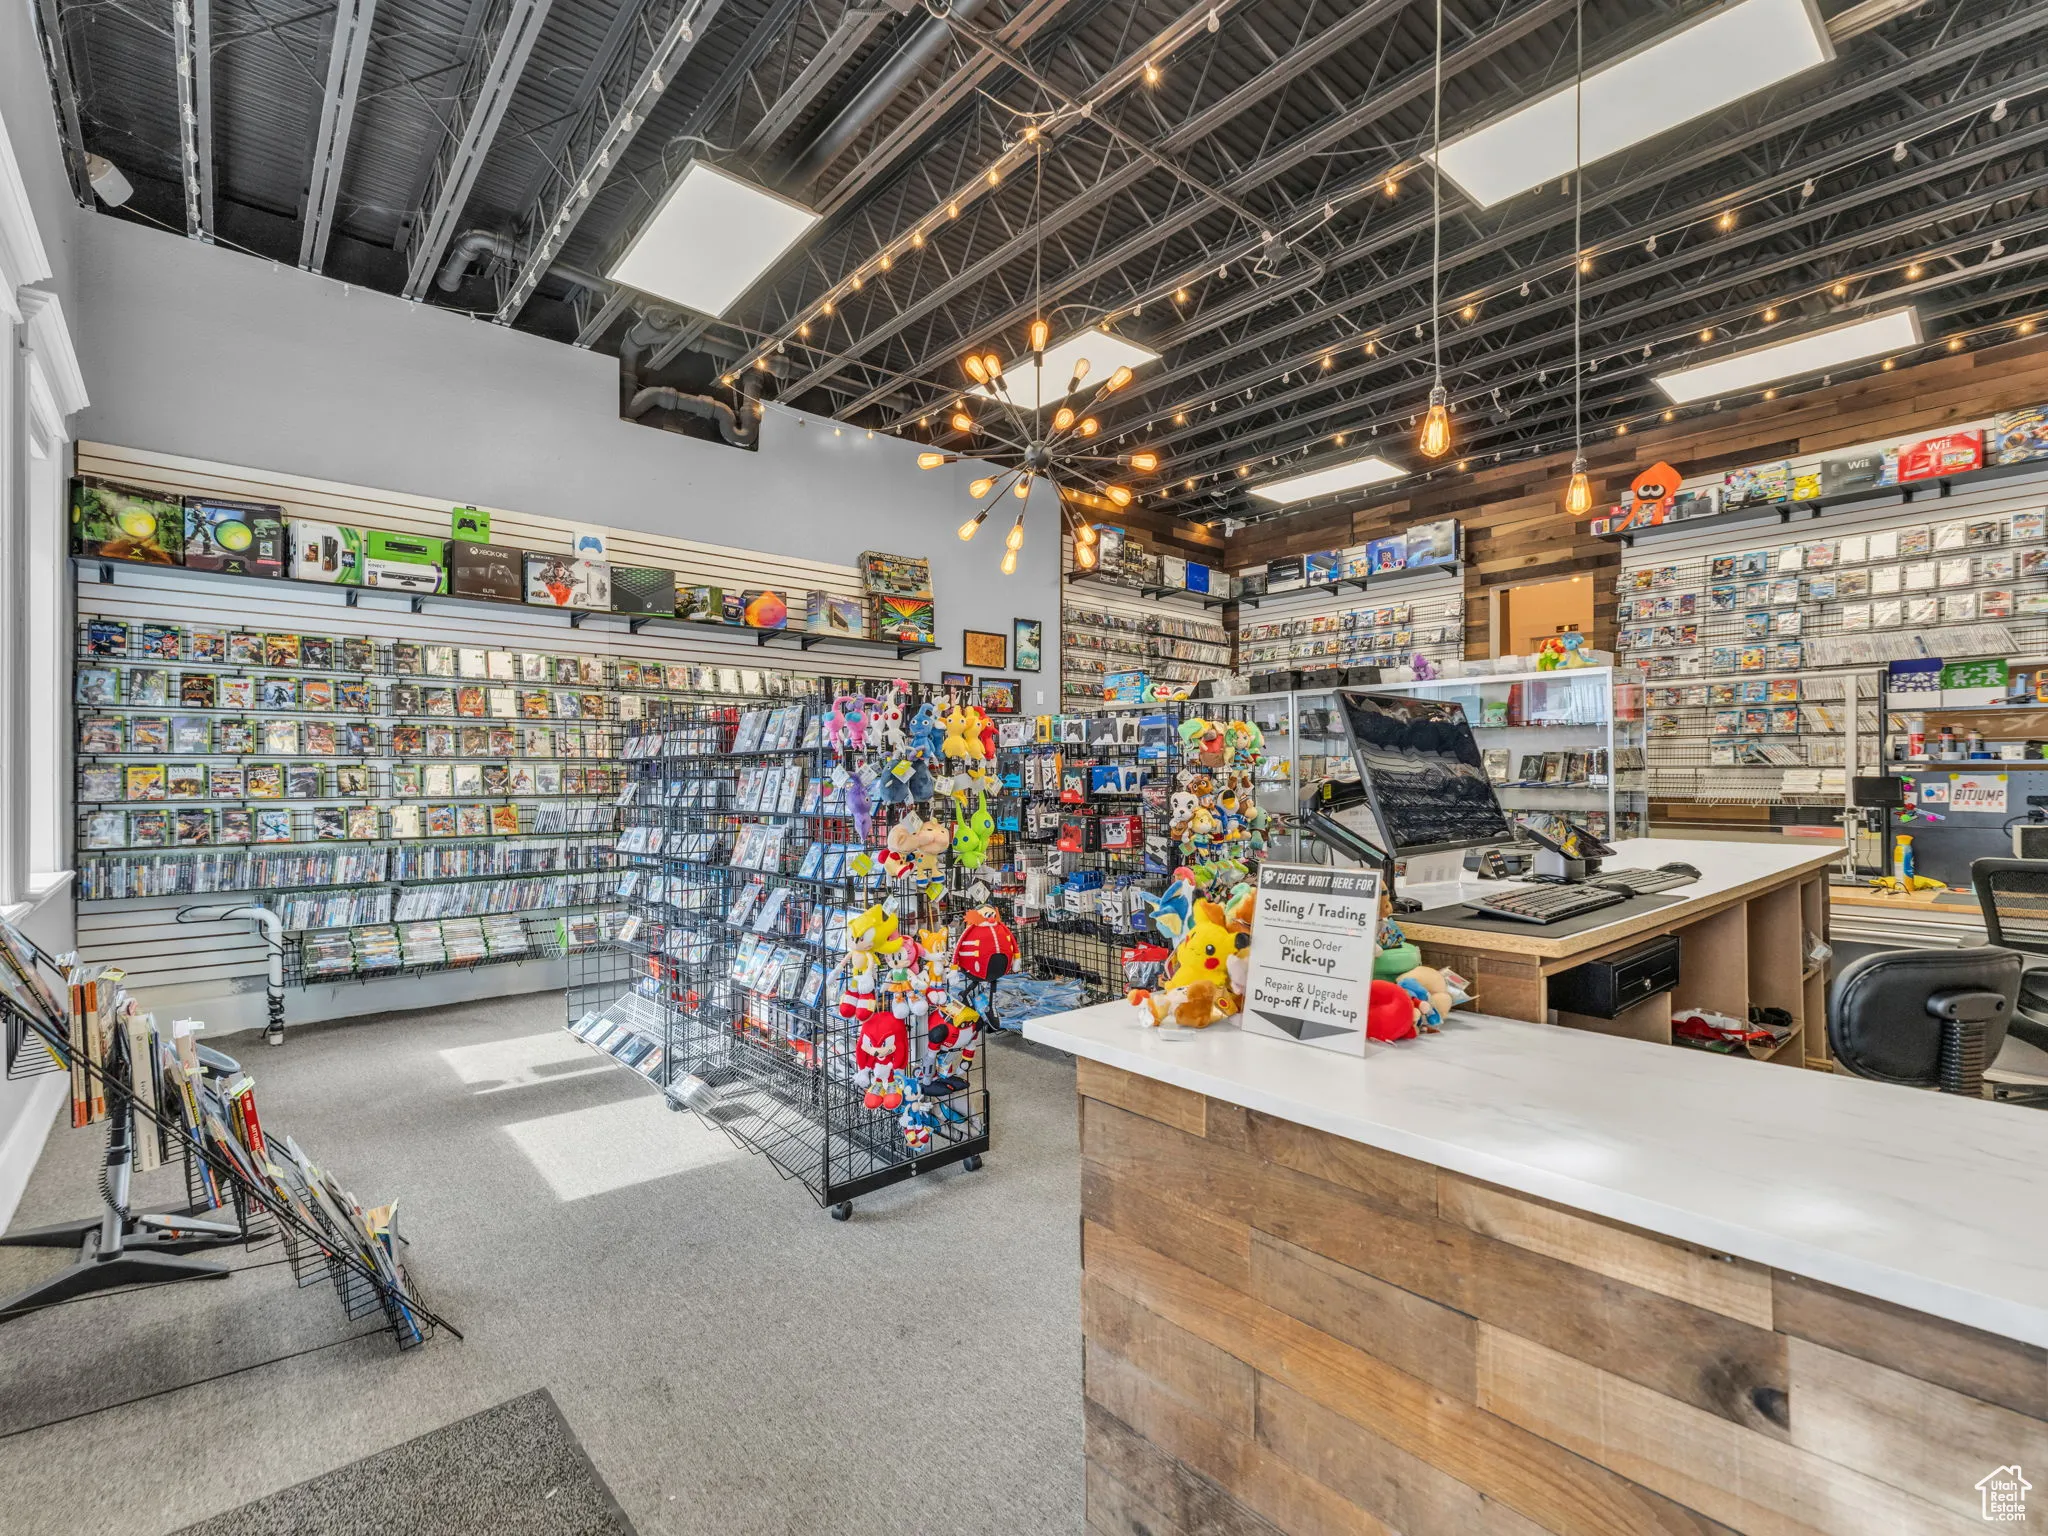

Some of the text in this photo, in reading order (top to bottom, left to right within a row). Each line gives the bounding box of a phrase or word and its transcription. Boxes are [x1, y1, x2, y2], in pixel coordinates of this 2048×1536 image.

[1926, 439, 1952, 451] Wii
[1847, 458, 1871, 470] Wii
[1954, 789, 2004, 801] BITJUMP
[1275, 873, 1374, 891] PLEASE WAIT HERE FOR
[1264, 898, 1305, 920] Selling
[1318, 903, 1367, 927] Trading
[1279, 934, 1343, 953] Online Order
[1281, 947, 1336, 974] Pick-up
[1265, 977, 1348, 1001] Repair & Upgrade
[1254, 989, 1301, 1009] Drop-off
[1312, 1000, 1358, 1023] Pick-up
